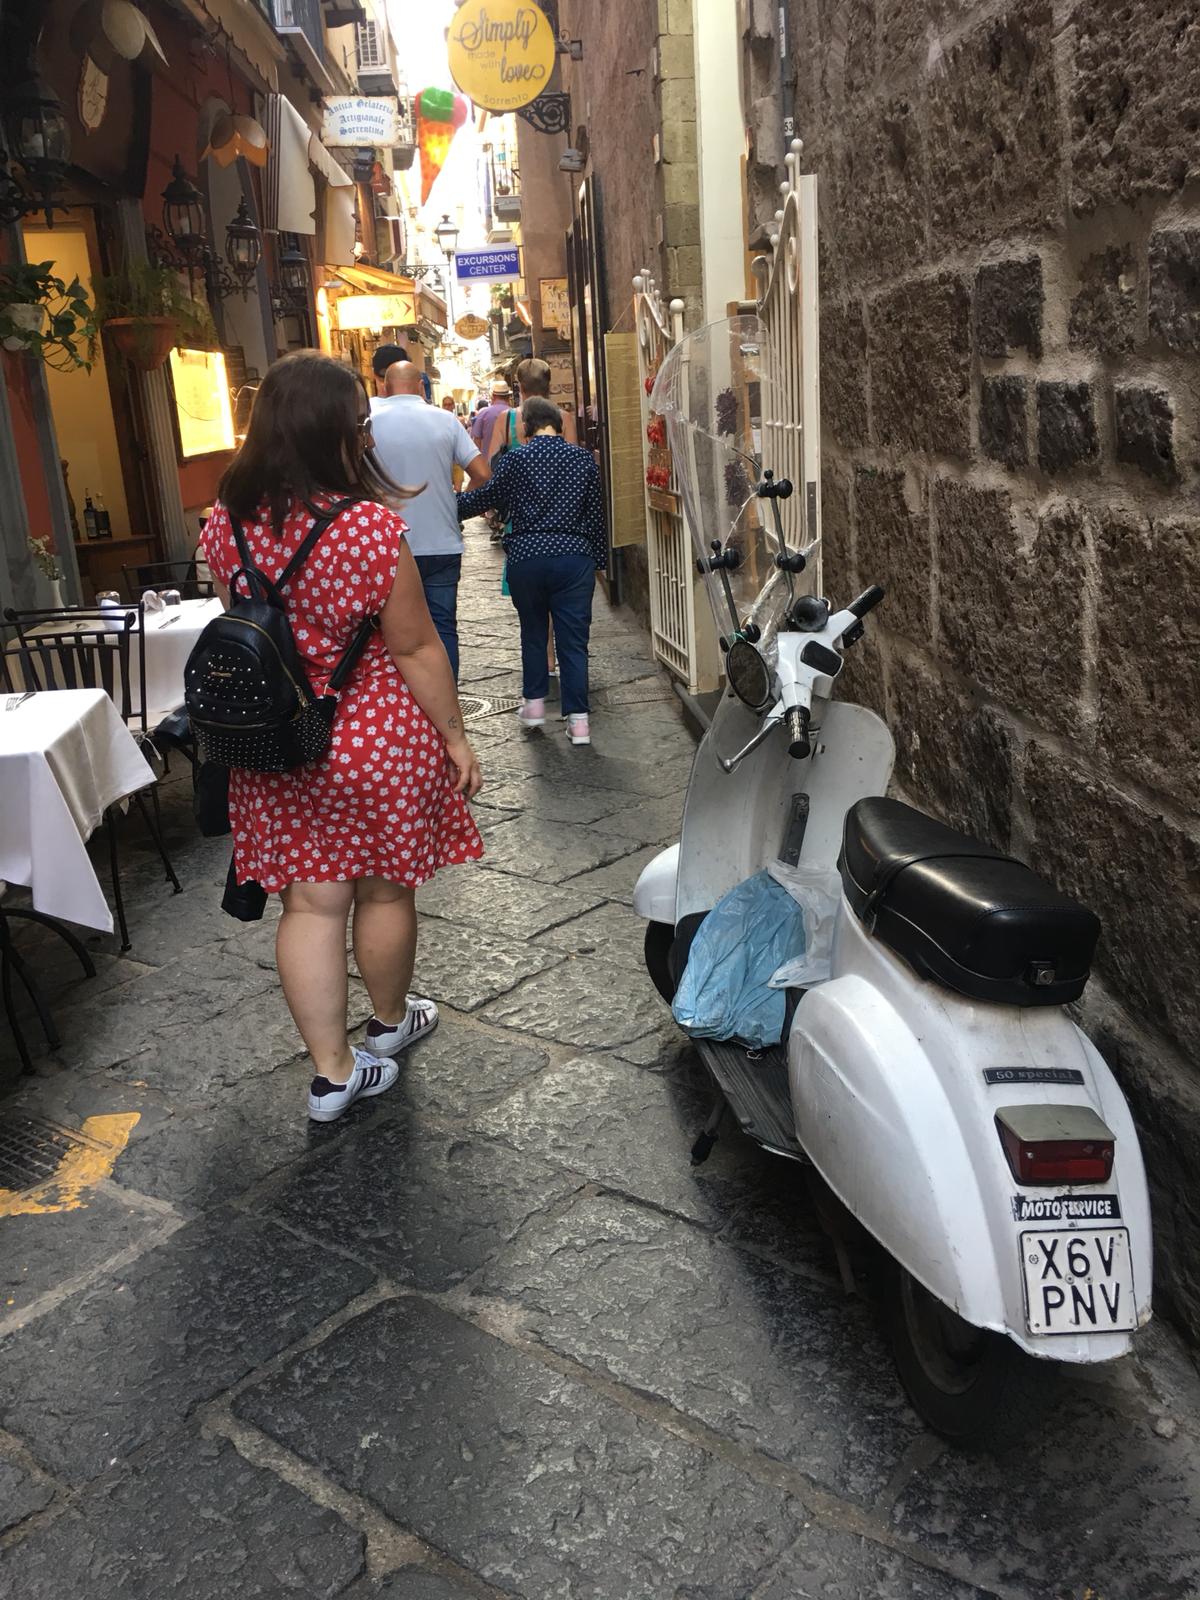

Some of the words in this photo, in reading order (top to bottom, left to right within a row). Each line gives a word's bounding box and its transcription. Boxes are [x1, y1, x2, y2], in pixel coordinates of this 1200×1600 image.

[453, 8, 537, 51] Simply
[467, 51, 495, 59] made
[480, 59, 500, 69] with
[500, 56, 545, 83] love
[484, 93, 529, 105] Sorrento
[328, 102, 353, 116] Antica
[356, 98, 394, 116] Gelateria
[339, 114, 385, 125] Artigianale
[339, 126, 384, 136] Sorrentina
[457, 253, 517, 266] EXCURSIONS
[469, 264, 506, 275] CENTER
[996, 1070, 1014, 1080] 50
[1018, 1070, 1074, 1082] special
[1021, 1199, 1112, 1218] MOTOSERVICE
[1037, 1236, 1115, 1280] X6V
[1042, 1282, 1120, 1327] PNV
